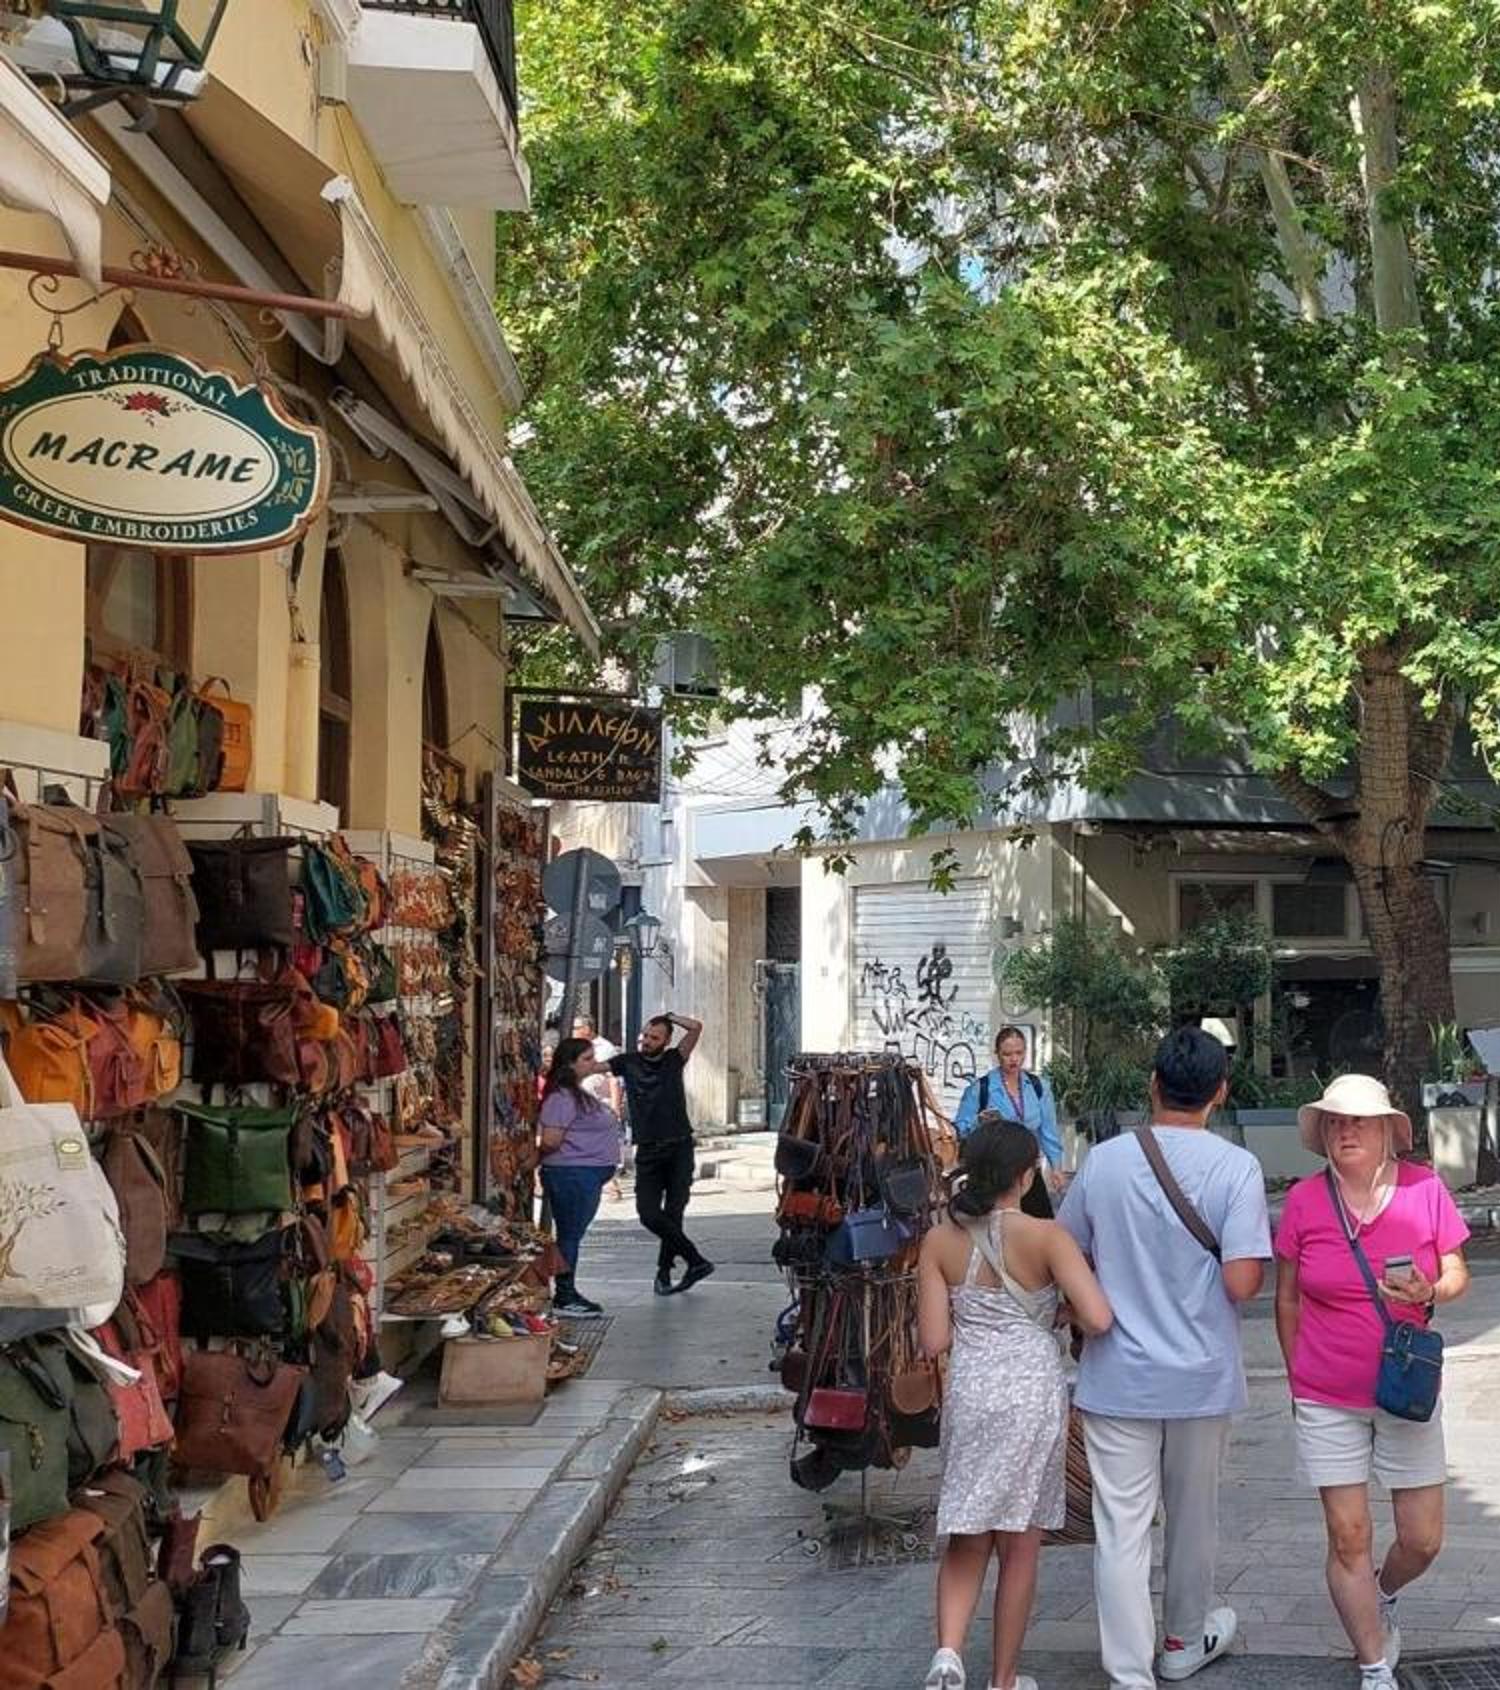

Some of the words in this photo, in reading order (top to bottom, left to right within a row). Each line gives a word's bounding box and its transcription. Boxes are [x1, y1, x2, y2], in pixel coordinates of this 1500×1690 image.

[72, 365, 230, 408] TRADITIONAL
[28, 432, 260, 483] MACRAME
[13, 483, 82, 528] GREEK
[90, 509, 259, 540] EMBROIDERIES
